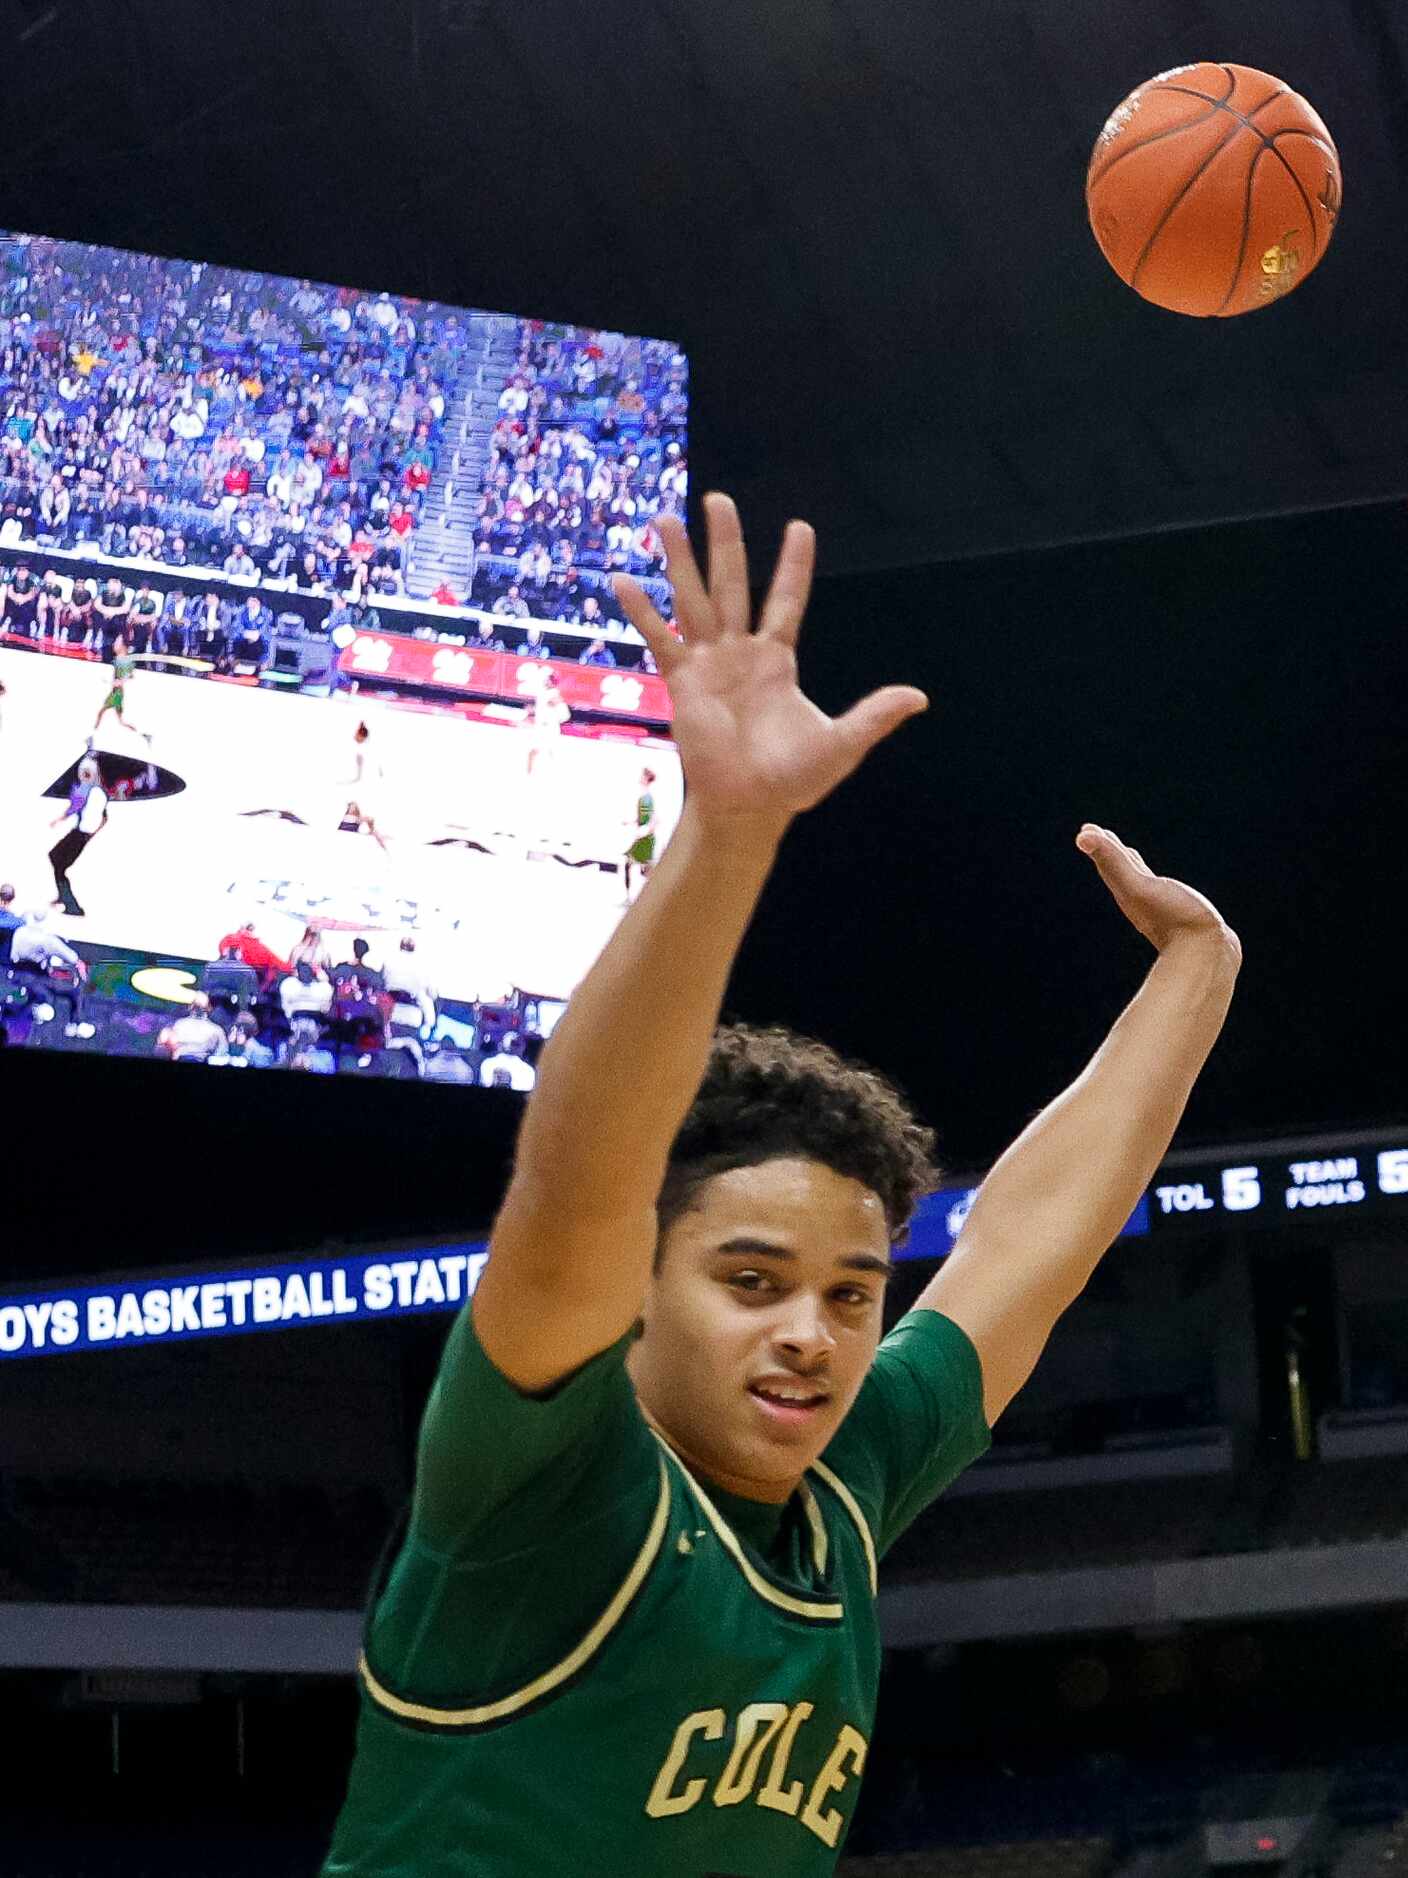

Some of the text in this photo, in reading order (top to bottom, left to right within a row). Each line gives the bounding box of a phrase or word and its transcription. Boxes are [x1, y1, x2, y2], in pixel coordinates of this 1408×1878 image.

[1156, 1166, 1261, 1214] TOL 5
[1286, 1180, 1366, 1209] FOULS
[1289, 1157, 1358, 1185] TEAM
[87, 1269, 357, 1342] BASKETBALL
[644, 1701, 869, 1848] COLE
